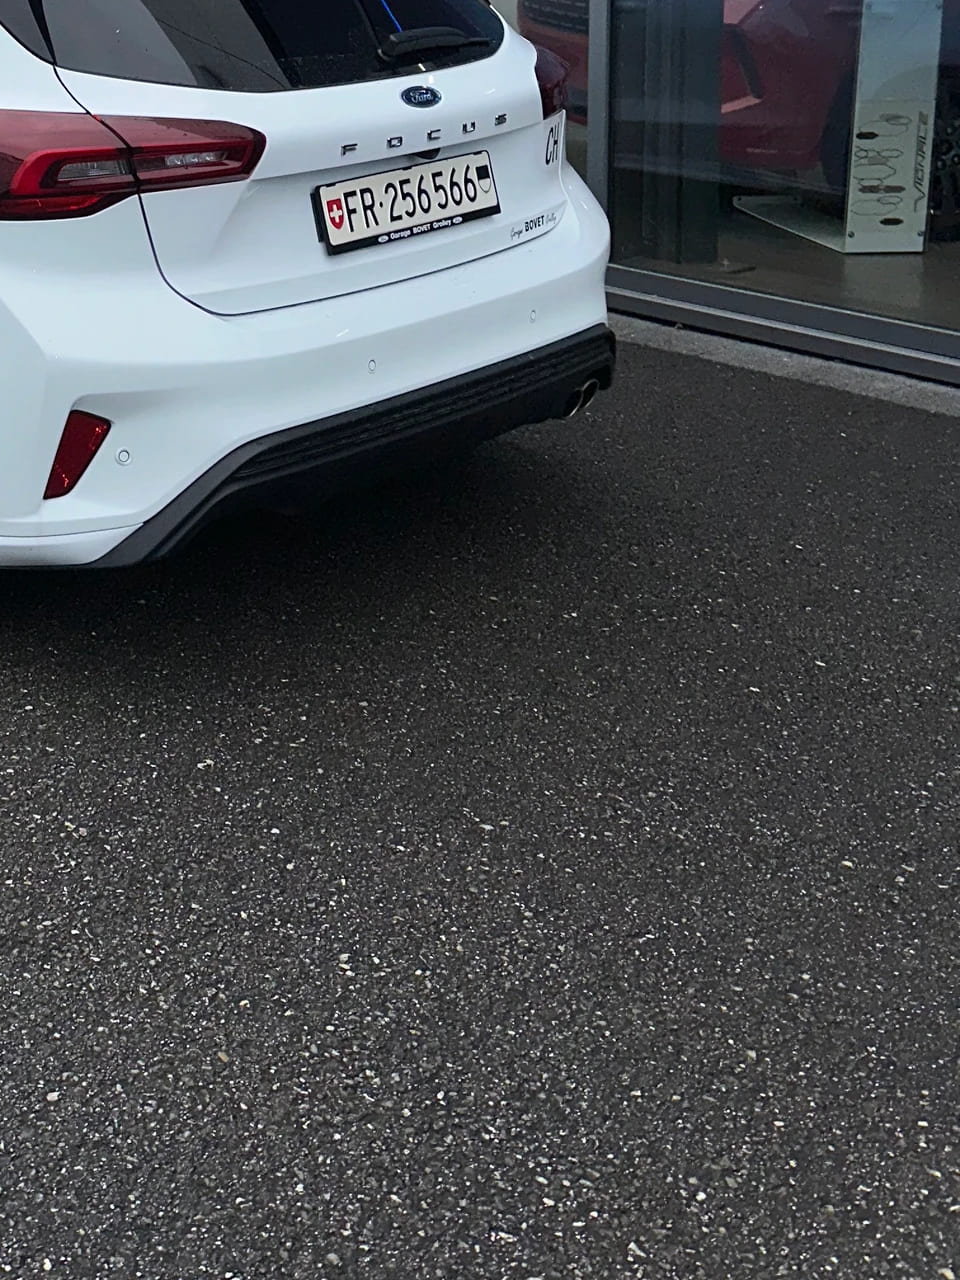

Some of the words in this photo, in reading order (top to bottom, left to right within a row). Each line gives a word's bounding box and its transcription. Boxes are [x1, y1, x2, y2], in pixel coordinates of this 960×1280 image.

[341, 114, 507, 156] FOCUS
[545, 122, 560, 165] CH
[413, 223, 431, 234] BOVET
[524, 214, 545, 232] BOVET
